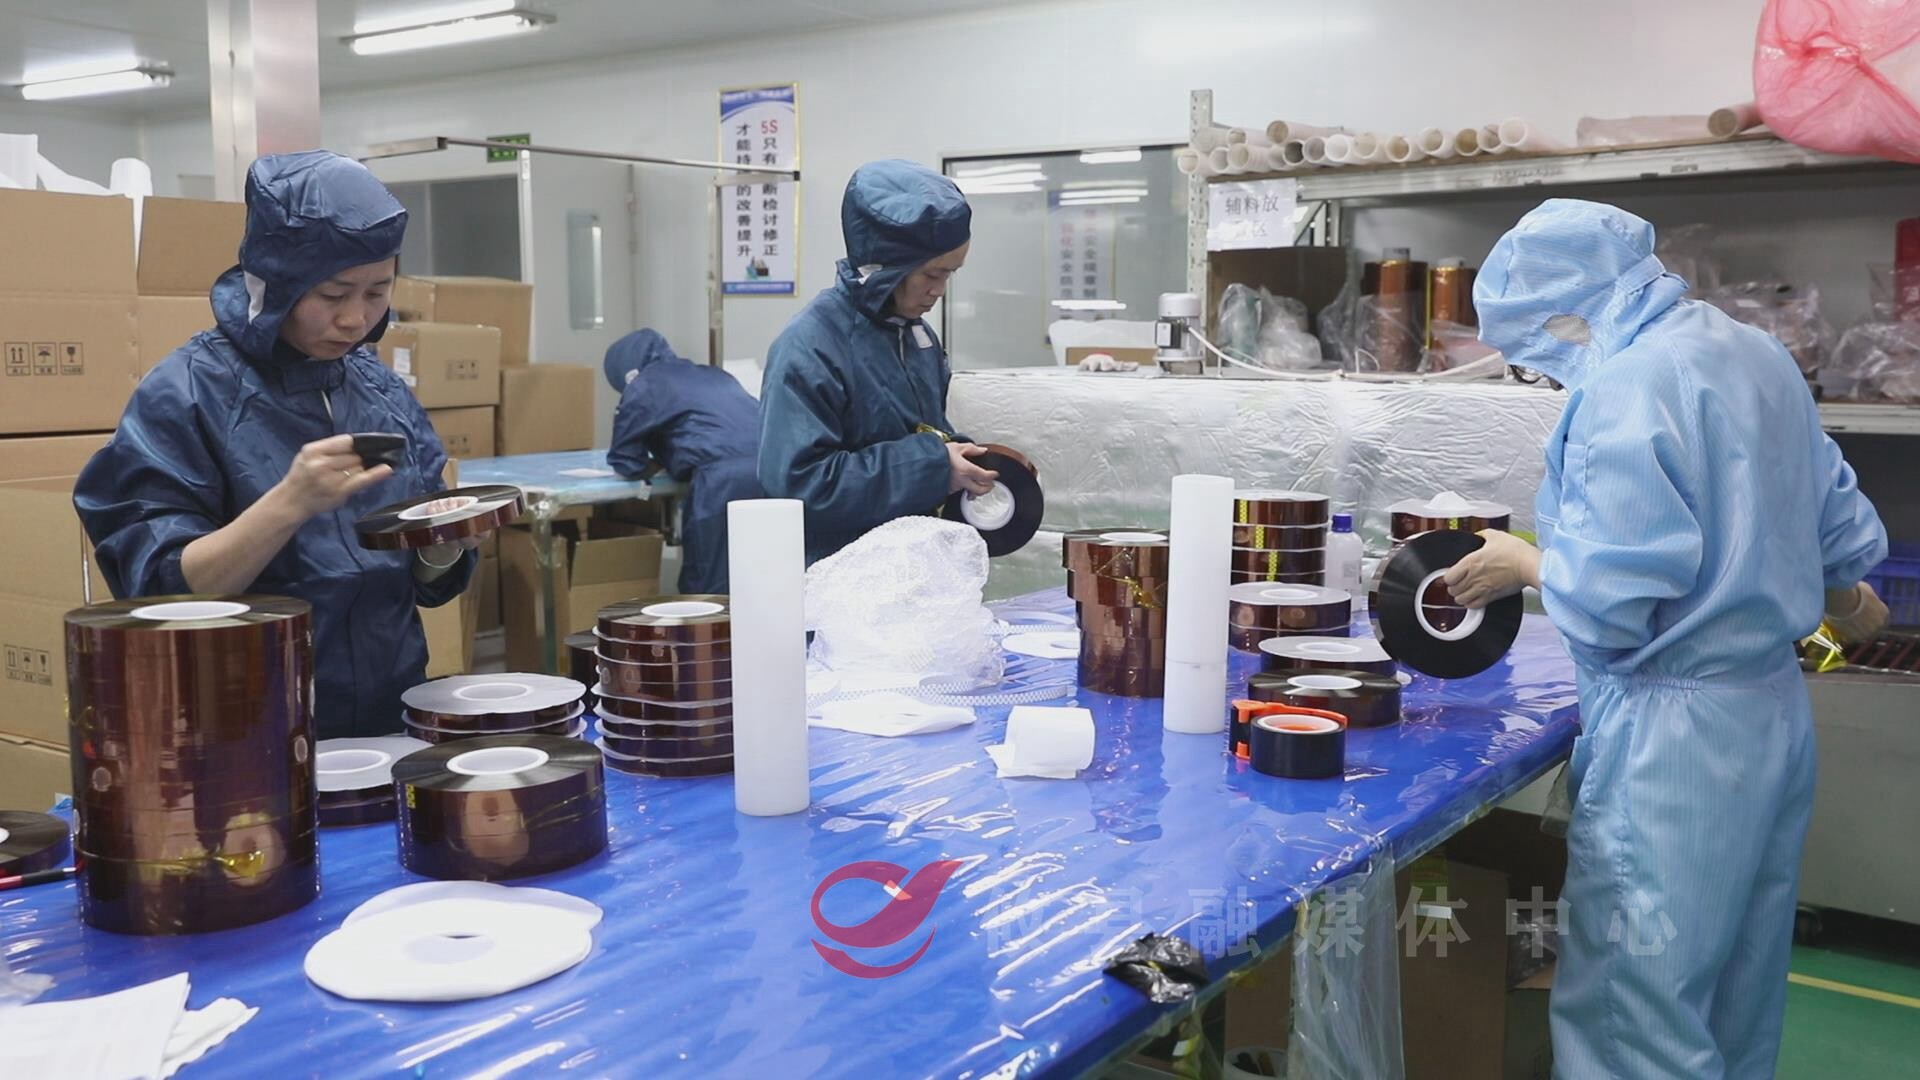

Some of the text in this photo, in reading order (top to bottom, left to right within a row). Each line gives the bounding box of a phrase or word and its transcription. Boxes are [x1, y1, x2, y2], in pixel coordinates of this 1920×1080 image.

[736, 123, 751, 257] 才能持的改善提升
[760, 119, 779, 256] 5S只有断检讨修正
[1225, 193, 1280, 216] 辅料放
